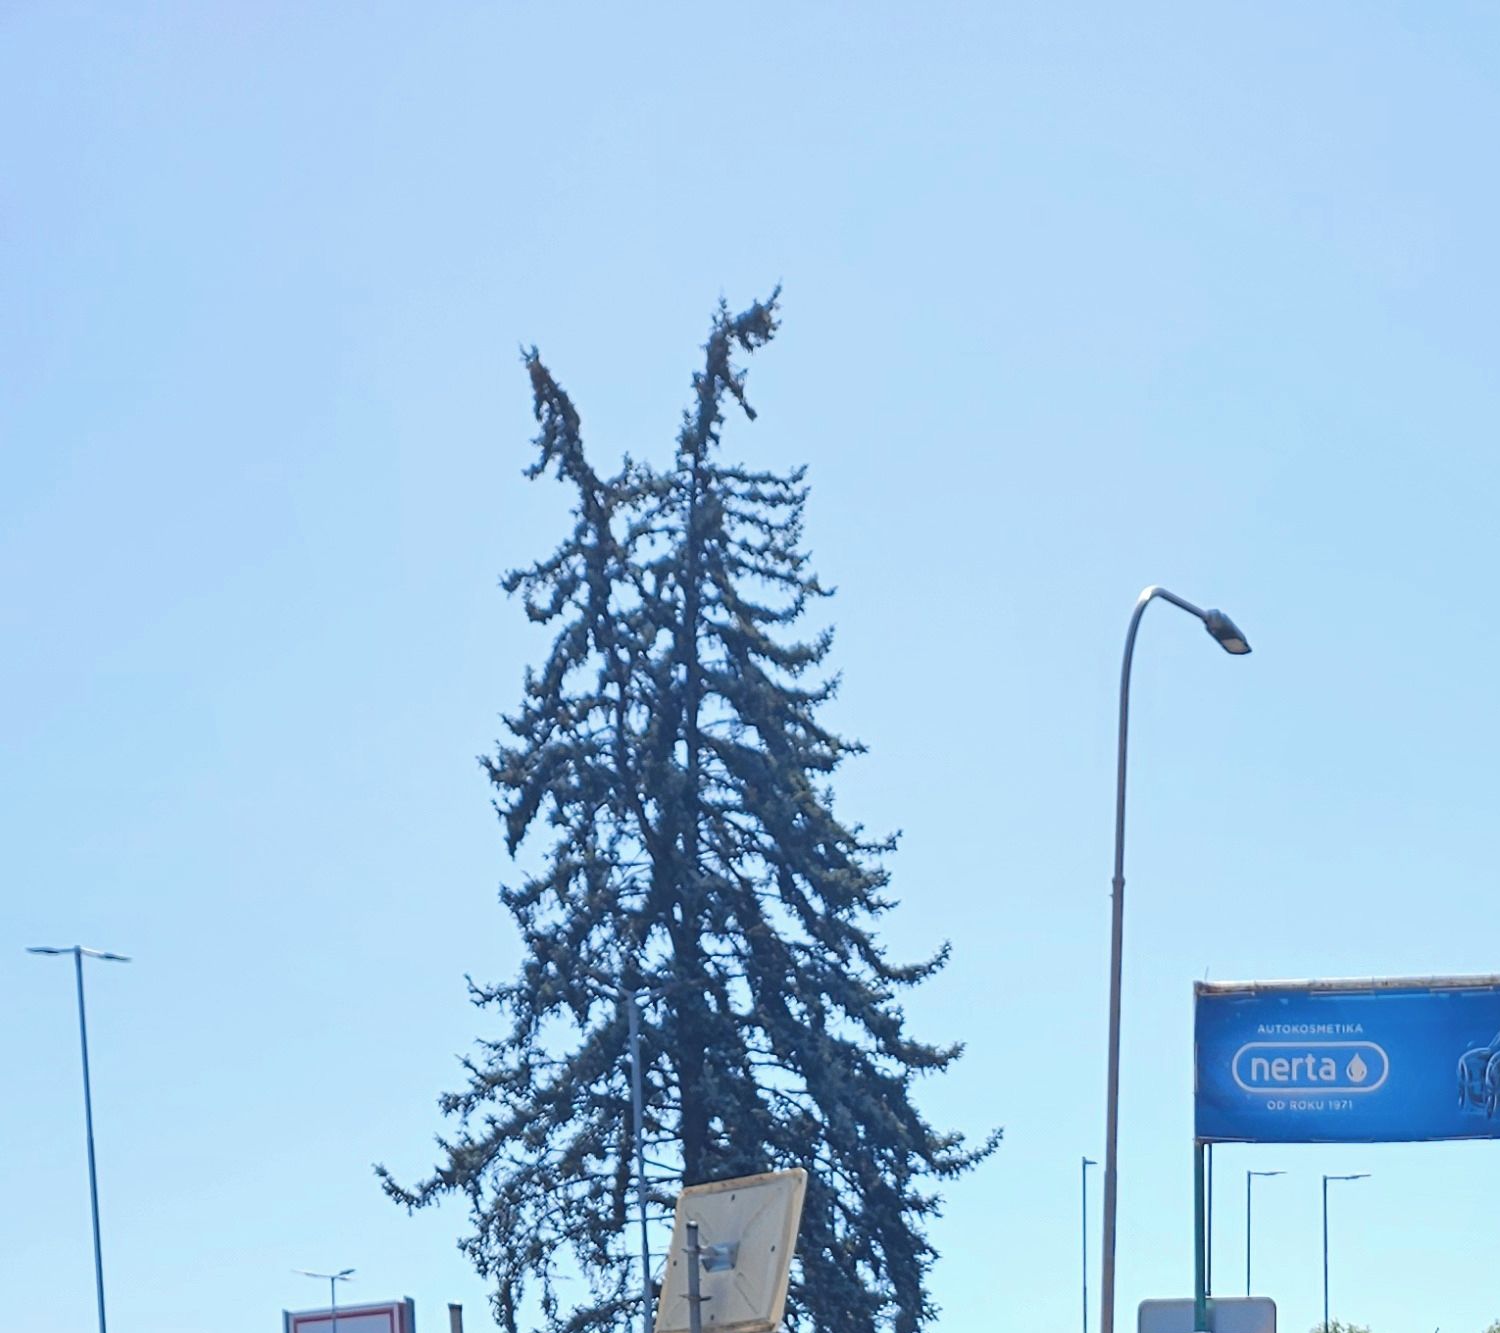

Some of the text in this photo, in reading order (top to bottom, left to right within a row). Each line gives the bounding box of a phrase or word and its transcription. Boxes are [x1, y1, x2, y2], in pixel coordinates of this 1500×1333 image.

[1257, 1023, 1364, 1034] AUTOKOSMETIKA
[1251, 1053, 1336, 1081] nerta
[1266, 1100, 1286, 1111] OD
[1289, 1099, 1325, 1111] ROKU
